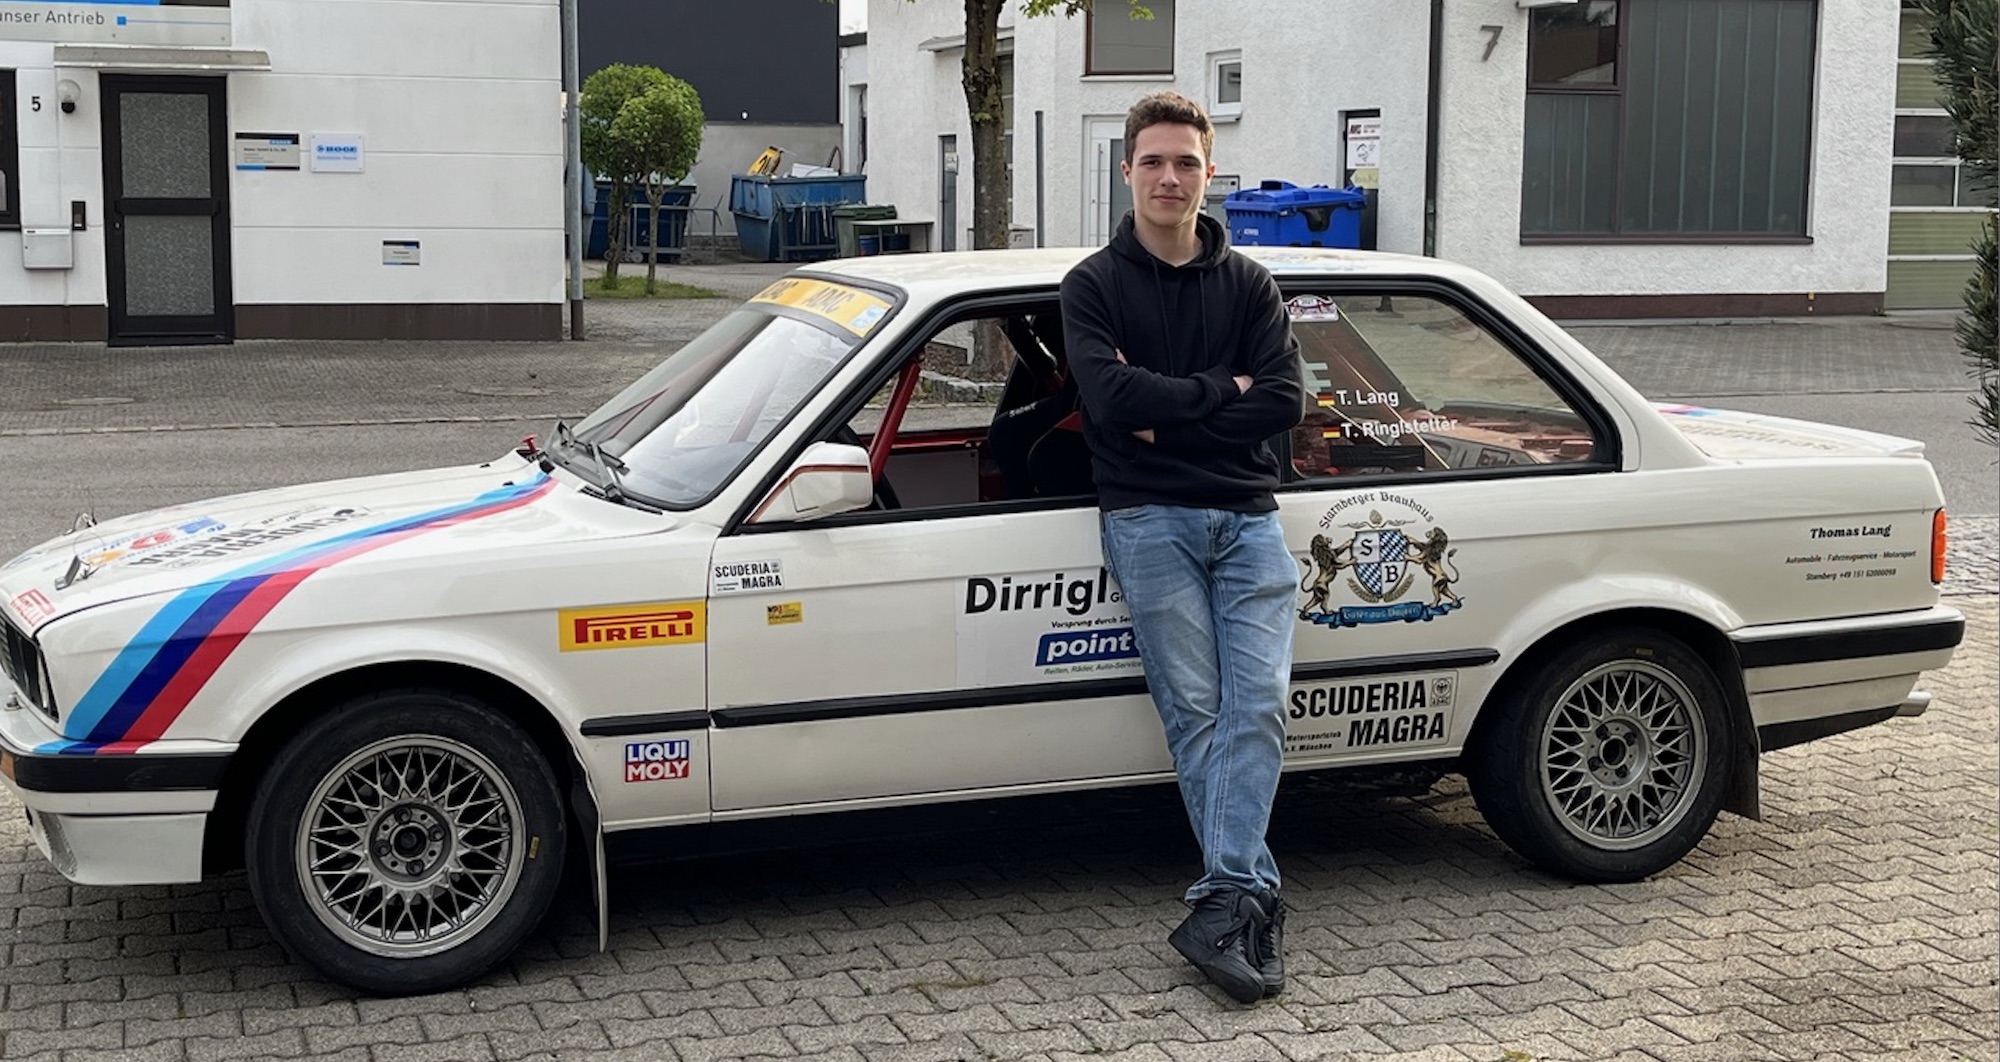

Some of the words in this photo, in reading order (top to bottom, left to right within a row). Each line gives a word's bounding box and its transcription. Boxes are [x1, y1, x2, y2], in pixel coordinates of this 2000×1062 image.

[0, 11, 40, 24] nser
[45, 9, 105, 25] Antrieb
[1480, 24, 1503, 62] 7
[32, 95, 41, 112] 5
[325, 145, 358, 154] BOGE
[1335, 389, 1352, 406] T.
[1355, 389, 1400, 408] Lang
[1340, 422, 1359, 438] T.
[1362, 416, 1458, 439] Ringlstetter
[1318, 491, 1376, 530] Starnberger
[1379, 491, 1435, 523] Brauhaus
[1809, 526, 1860, 540] Thomas
[1861, 524, 1892, 538] Lang
[1360, 538, 1373, 557] S
[1785, 555, 1822, 565] Automobile
[1883, 549, 1917, 560] Motorsport
[714, 561, 770, 579] SCUDERIA
[1385, 565, 1398, 583] B
[741, 574, 782, 590] MAGRA
[965, 566, 1108, 616] Dirrigl
[574, 610, 694, 644] PIRELLI
[1051, 618, 1093, 630] Vorsprung
[1094, 616, 1117, 626] durch
[1046, 631, 1133, 662] point
[1290, 679, 1427, 720] SCUDERIA
[1347, 711, 1445, 747] MAGRA
[626, 741, 689, 763] LIQUI
[626, 761, 689, 781] MOLY
